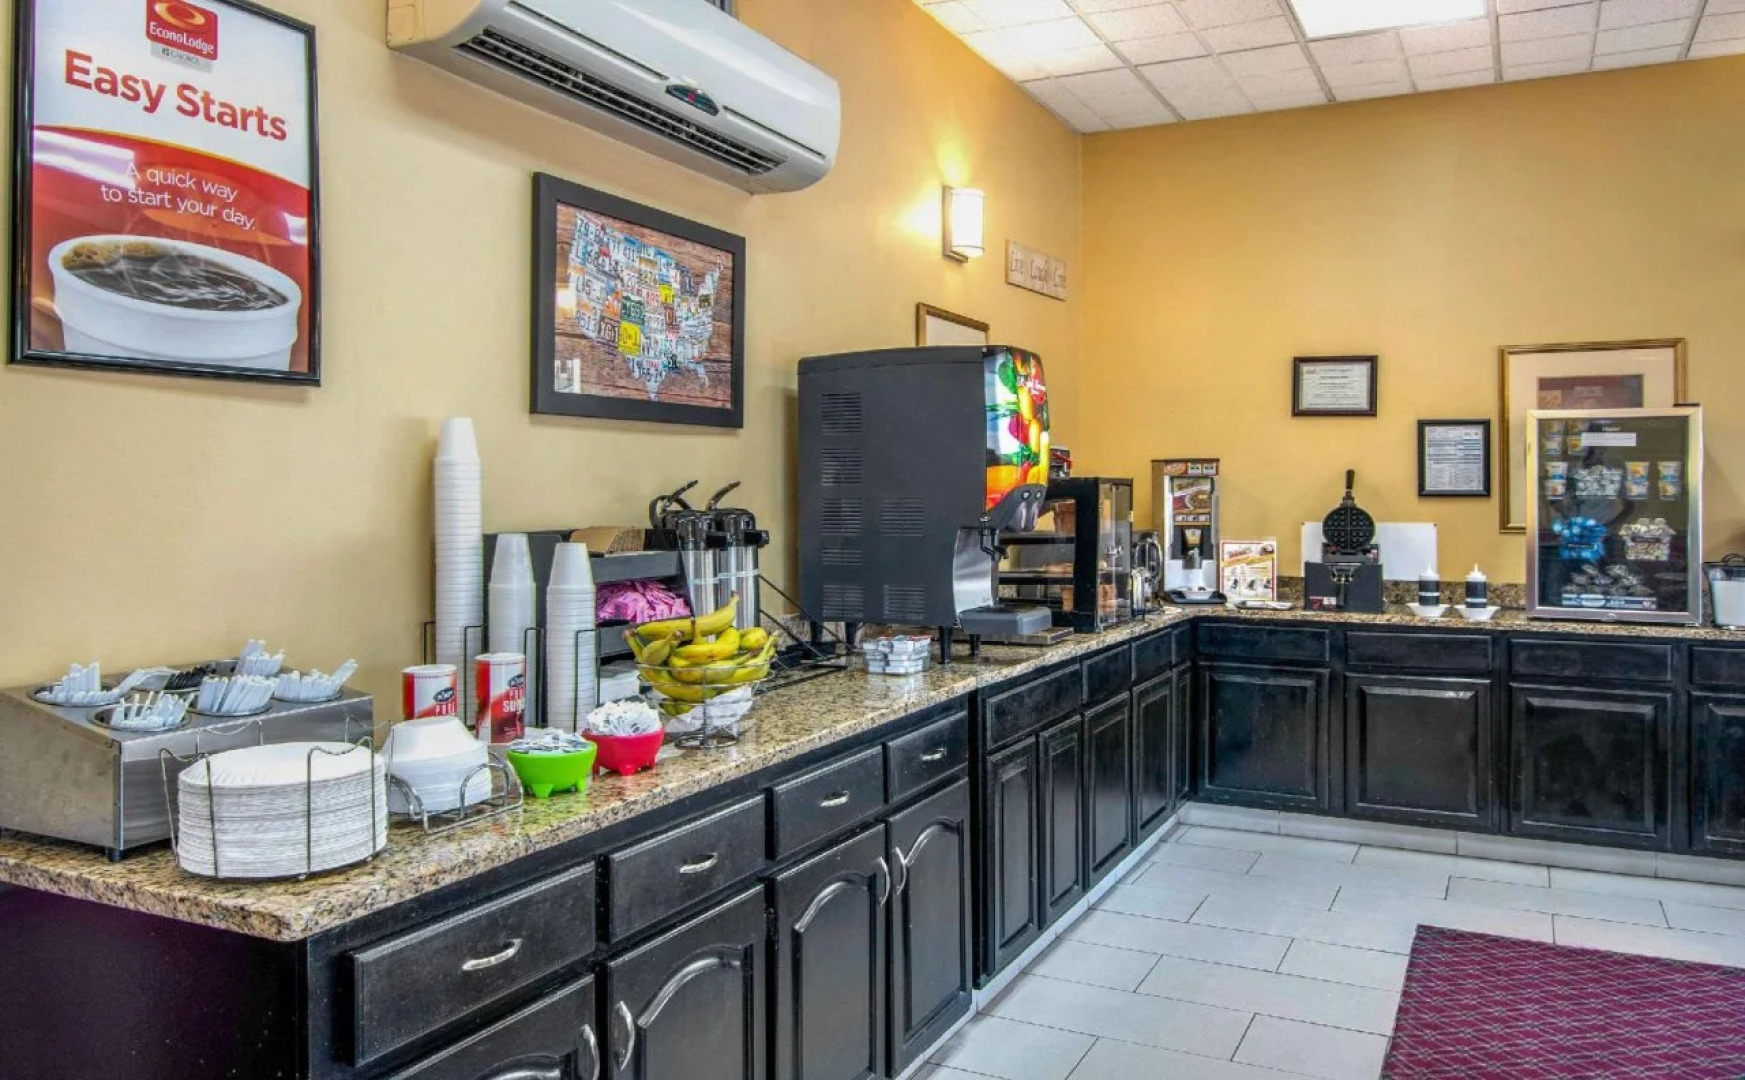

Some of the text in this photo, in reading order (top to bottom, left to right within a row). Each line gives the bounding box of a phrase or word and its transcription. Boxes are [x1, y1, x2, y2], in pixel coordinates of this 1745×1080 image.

[150, 22, 214, 53] EconoLodge
[65, 48, 288, 141] Easy Starts
[125, 162, 238, 203] A quick way
[100, 184, 256, 231] to start your day.
